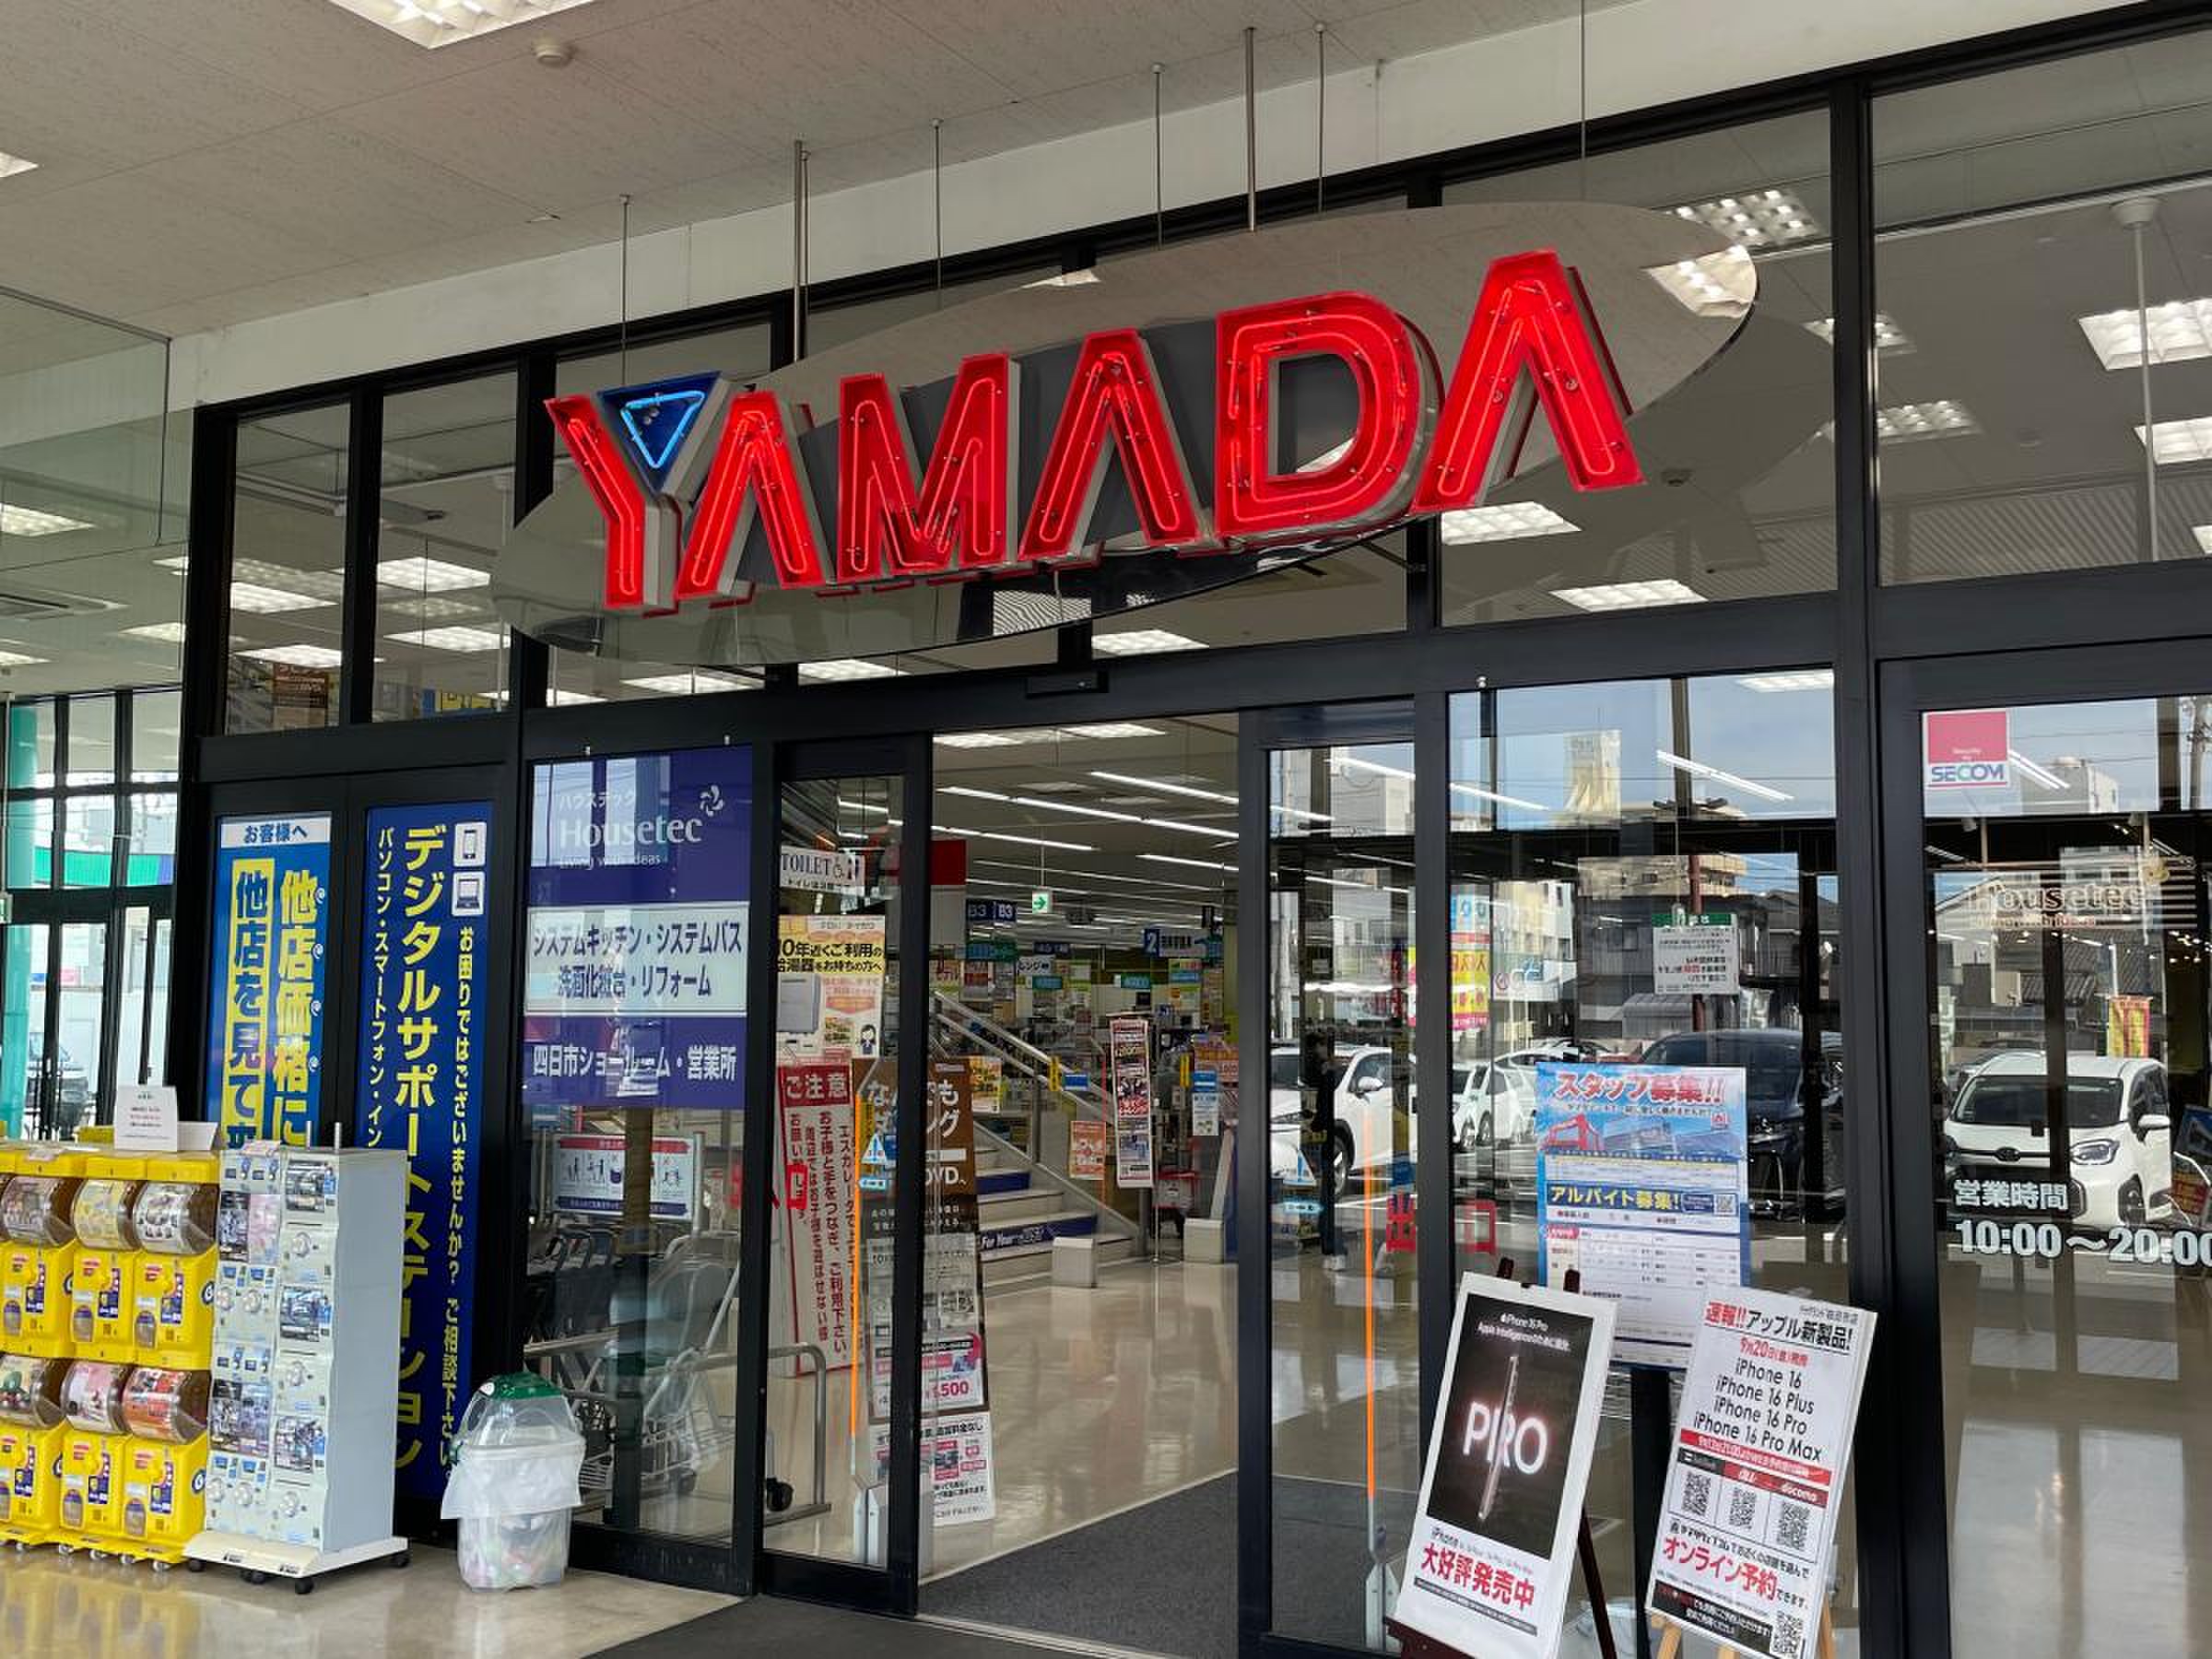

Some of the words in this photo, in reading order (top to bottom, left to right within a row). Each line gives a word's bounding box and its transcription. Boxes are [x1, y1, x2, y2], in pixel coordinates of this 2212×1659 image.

[544, 249, 1645, 610] YAMADA
[1932, 763, 2005, 782] SECOM
[244, 823, 308, 845] お客様へ
[559, 815, 703, 849] Housetec
[781, 853, 830, 876] TOILET
[533, 922, 742, 957] システムキッチン・システムバス
[785, 1074, 850, 1100] ご注意
[1953, 1179, 2069, 1210] 営業時間
[1735, 1357, 1784, 1384] iPhone
[1789, 1369, 1803, 1389] 16
[1715, 1373, 1764, 1403] iPhone
[1769, 1386, 1782, 1407] 16
[1784, 1391, 1815, 1415] Plus
[1712, 1394, 1762, 1423] iPhone
[1767, 1408, 1780, 1429] 16
[1783, 1414, 1808, 1435] Pro
[1693, 1411, 1740, 1439] iPhone
[1745, 1424, 1758, 1445] 16
[1761, 1430, 1785, 1453] Pro
[1788, 1439, 1823, 1463] Max
[1420, 1542, 1535, 1611] 大好評発売中
